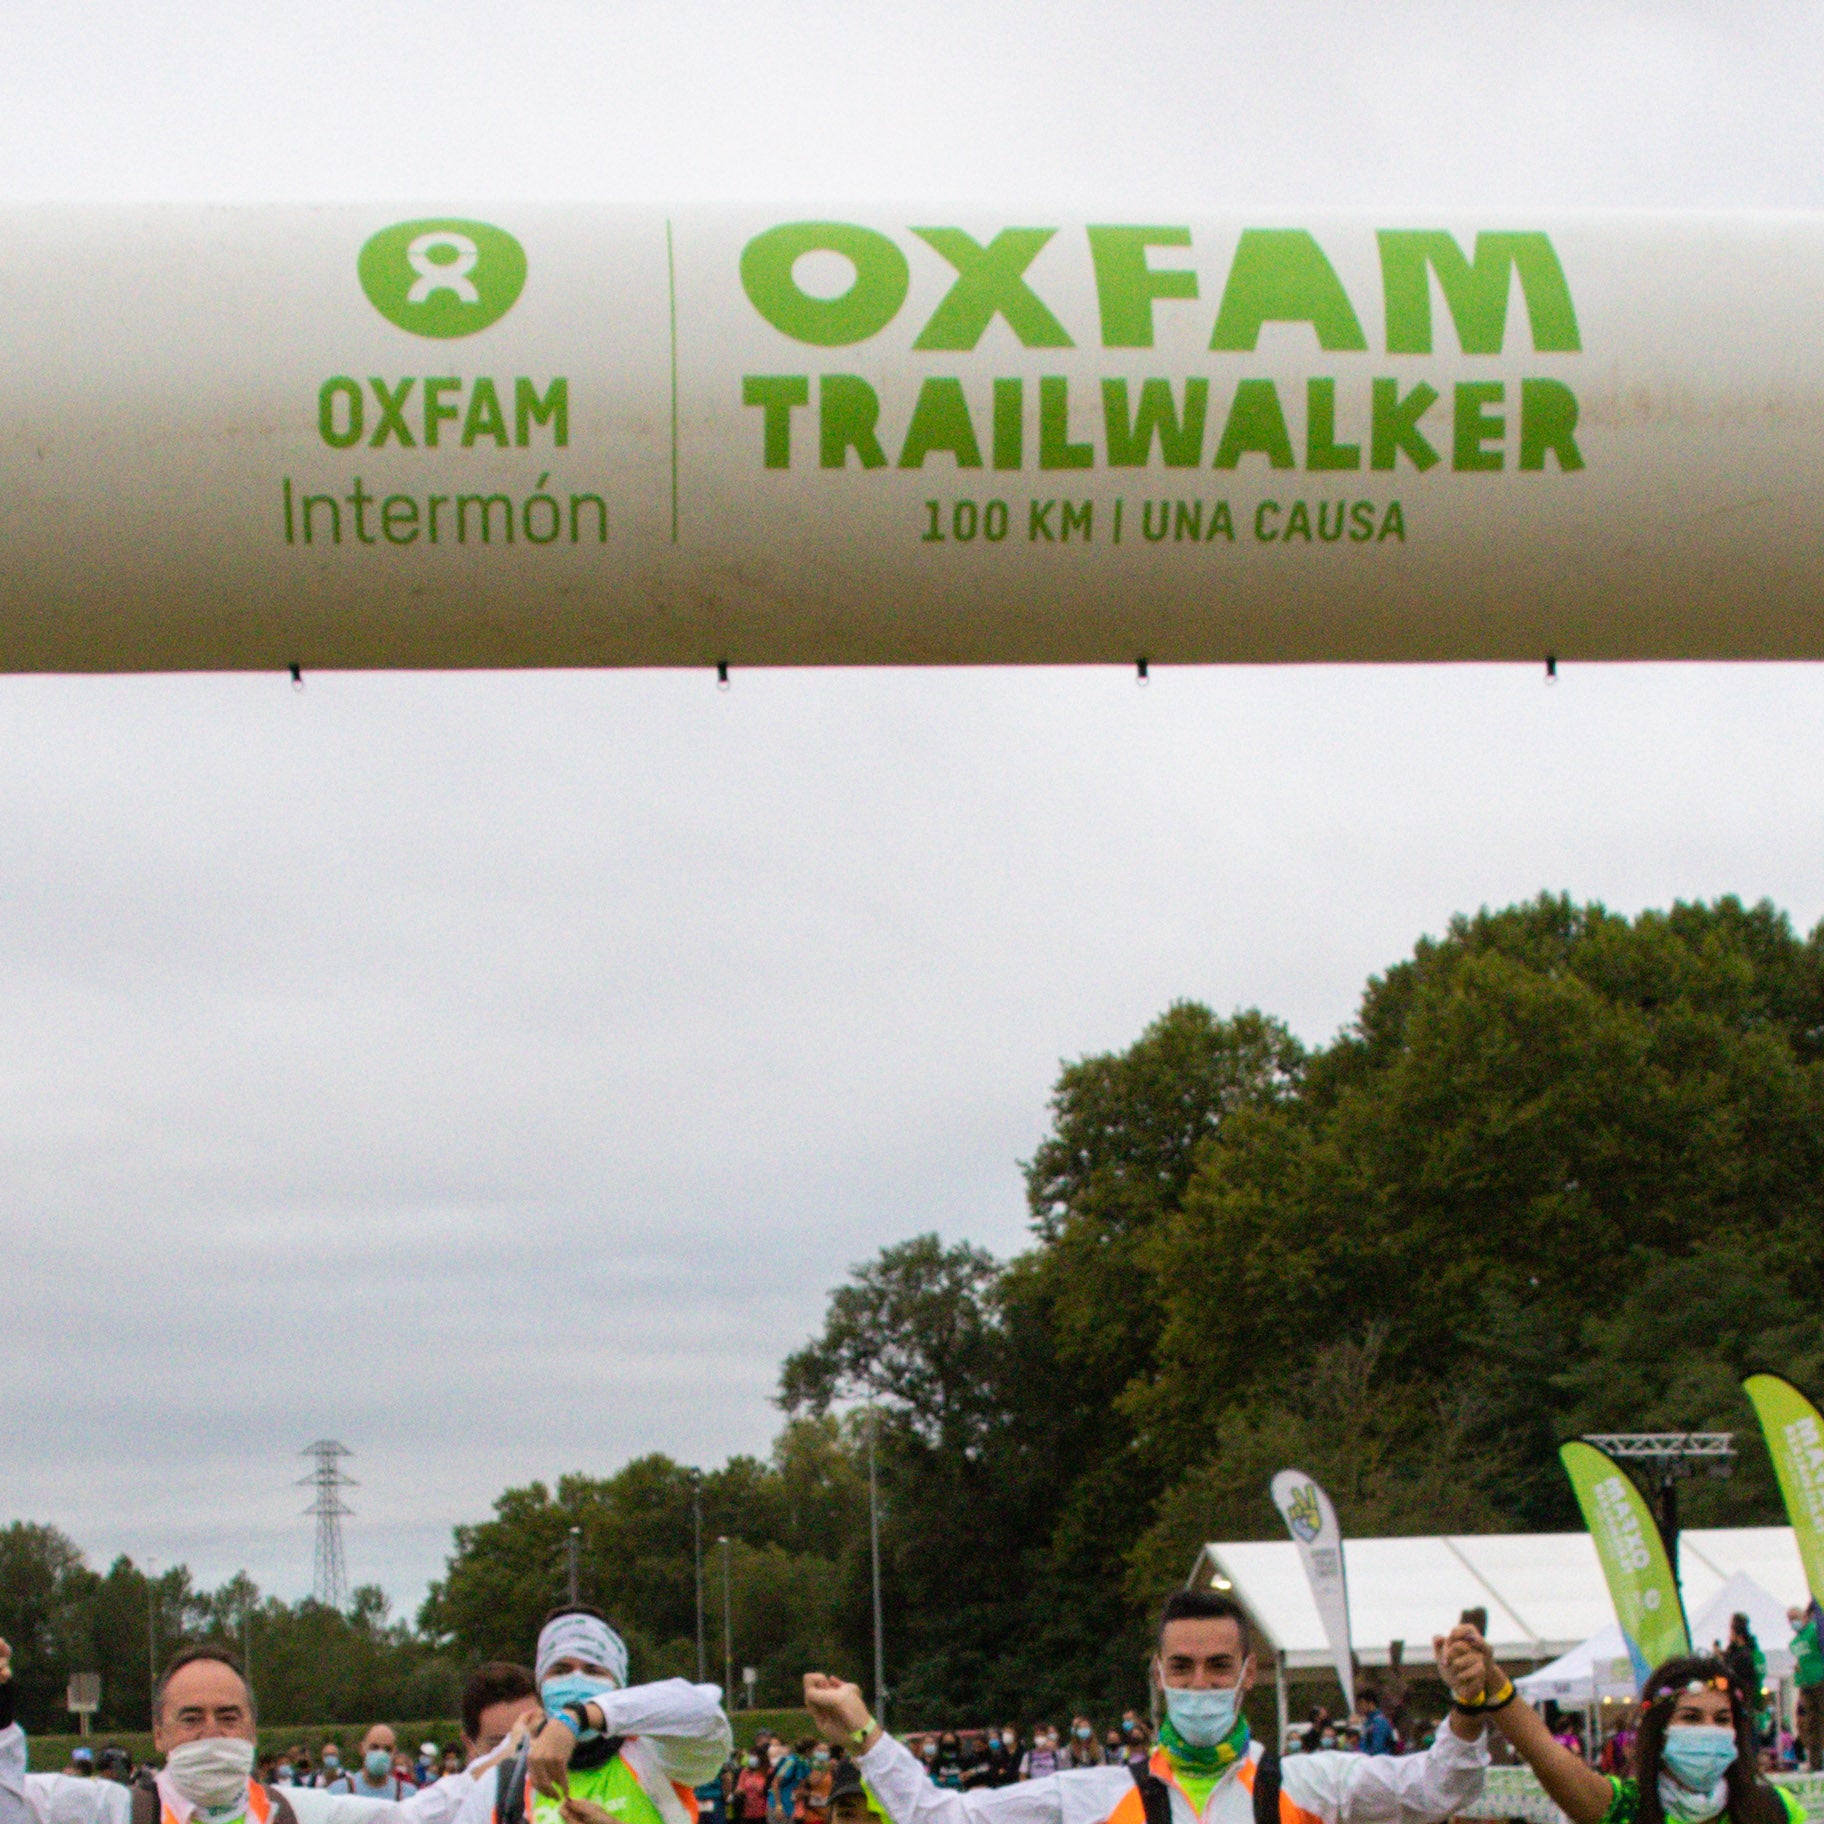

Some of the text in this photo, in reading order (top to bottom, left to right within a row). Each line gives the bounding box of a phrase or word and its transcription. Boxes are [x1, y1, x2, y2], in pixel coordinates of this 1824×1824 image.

[739, 221, 1581, 355] OXFAM
[318, 376, 569, 449] OXFAM
[741, 374, 1586, 473] TRAILWALKER
[282, 472, 608, 545] Intermón
[921, 500, 1010, 543] 100
[1028, 500, 1094, 543] KM
[1142, 500, 1236, 543] UNA
[1253, 500, 1407, 543] CAUSA
